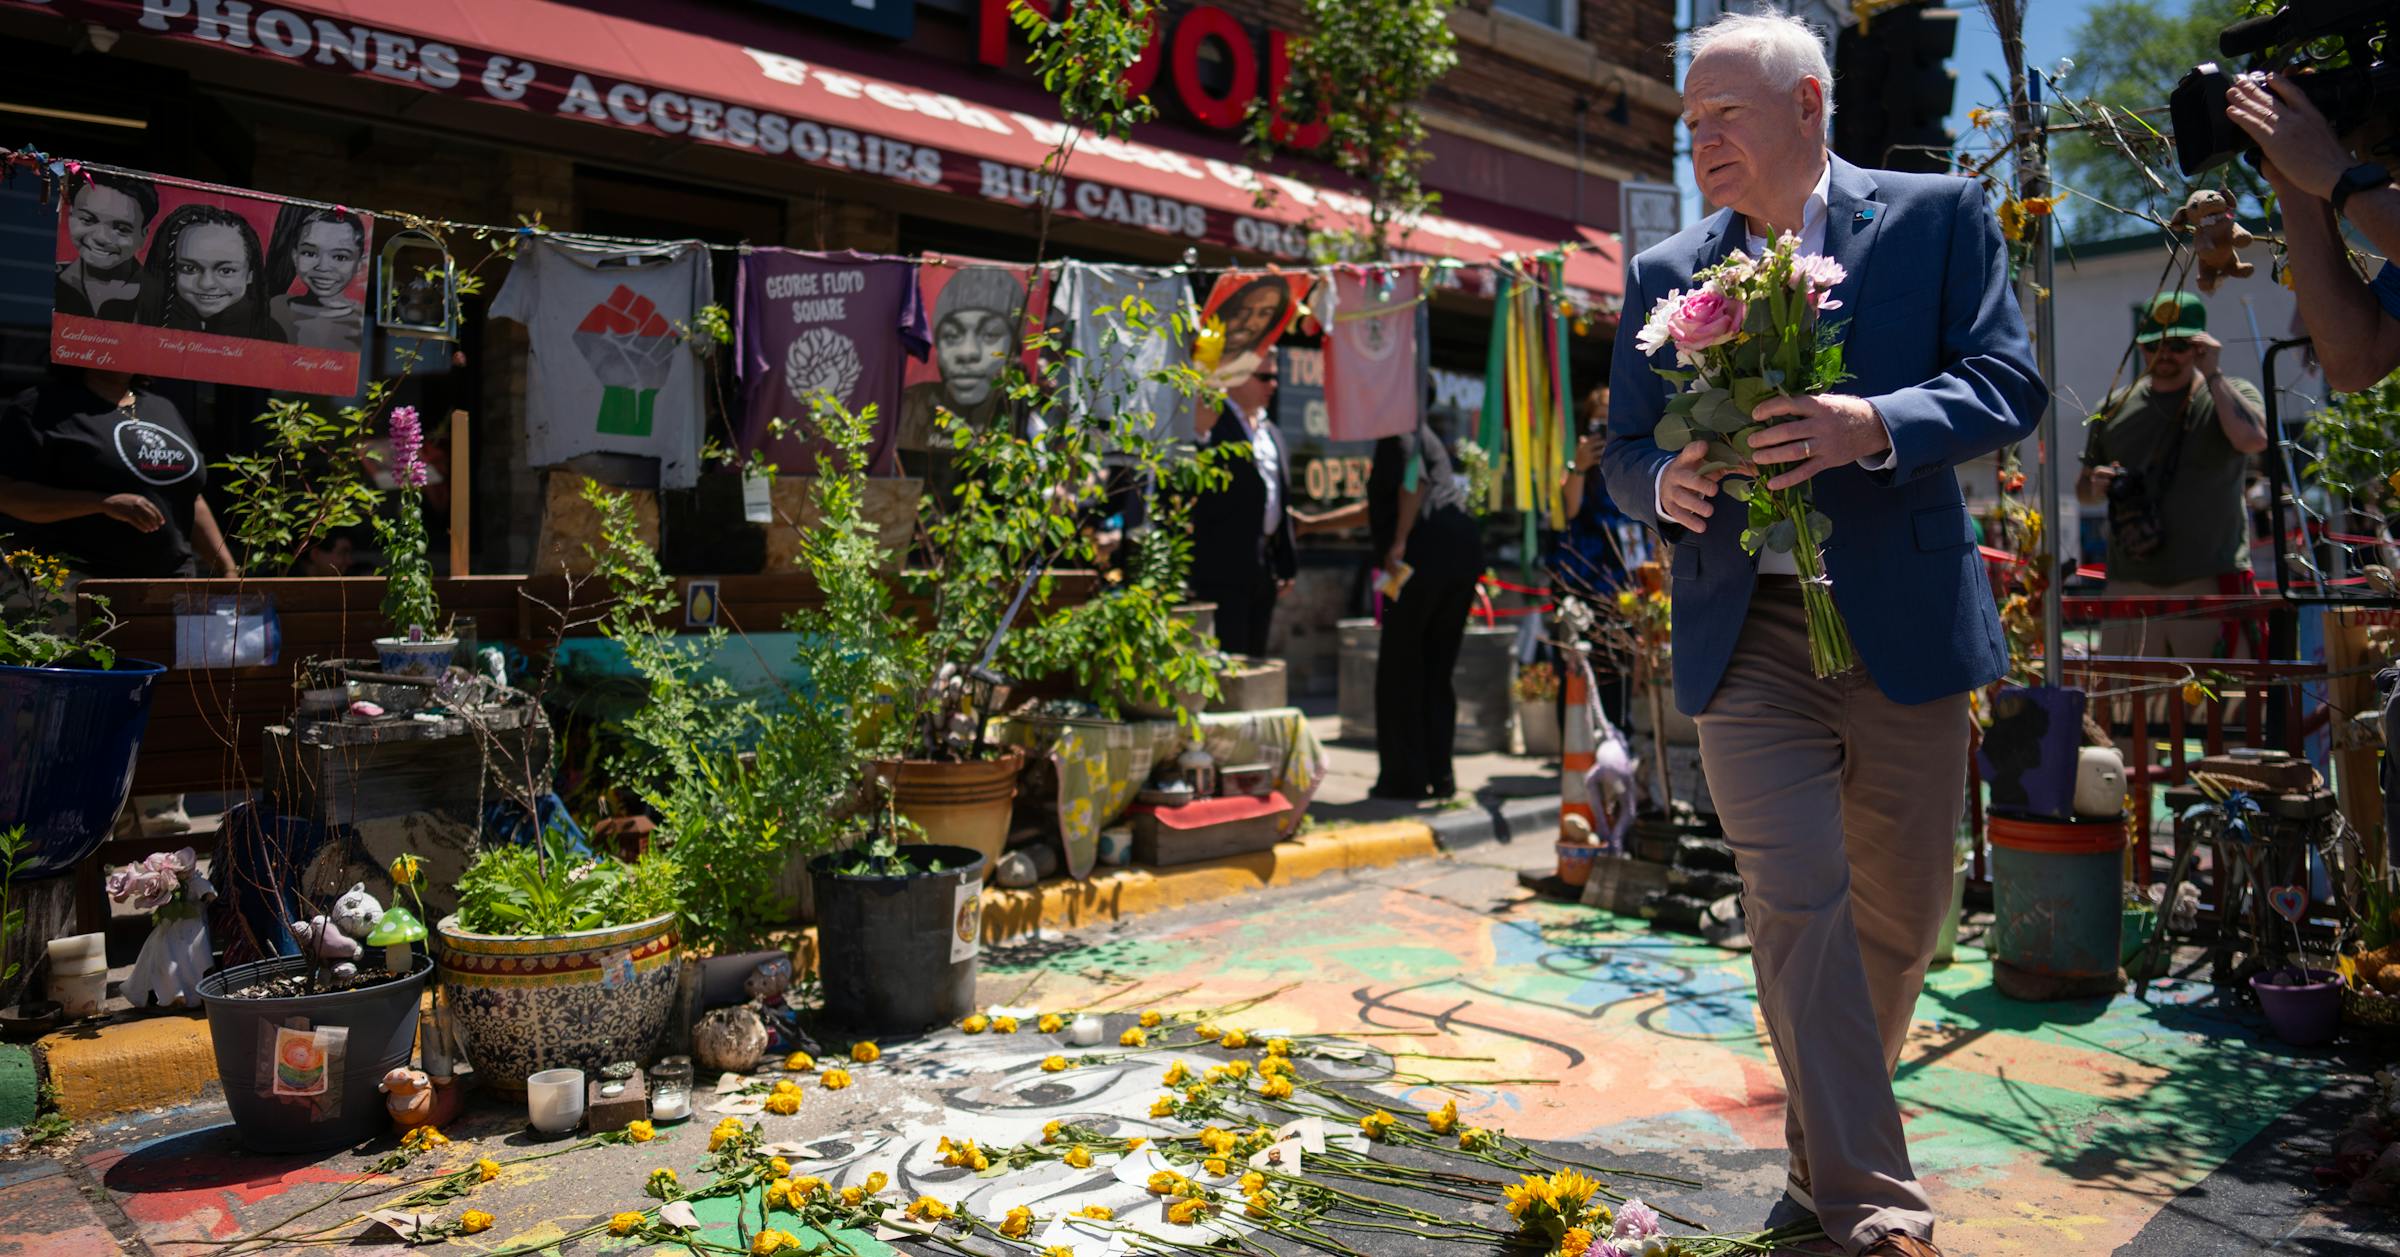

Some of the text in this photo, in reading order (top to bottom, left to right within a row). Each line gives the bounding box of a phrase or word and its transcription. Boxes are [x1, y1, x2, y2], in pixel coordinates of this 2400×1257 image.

[137, 0, 462, 89] PHONES
[480, 55, 537, 101] &
[558, 73, 944, 186] ACCESSORIES
[978, 160, 1066, 211] BUS
[1074, 181, 1207, 238] CARDS
[744, 48, 1014, 136] Fresh
[1008, 111, 1205, 179] Meat
[766, 269, 865, 299] GEORGE FLOYD
[792, 297, 846, 324] SQUARE
[138, 444, 186, 467] Agape
